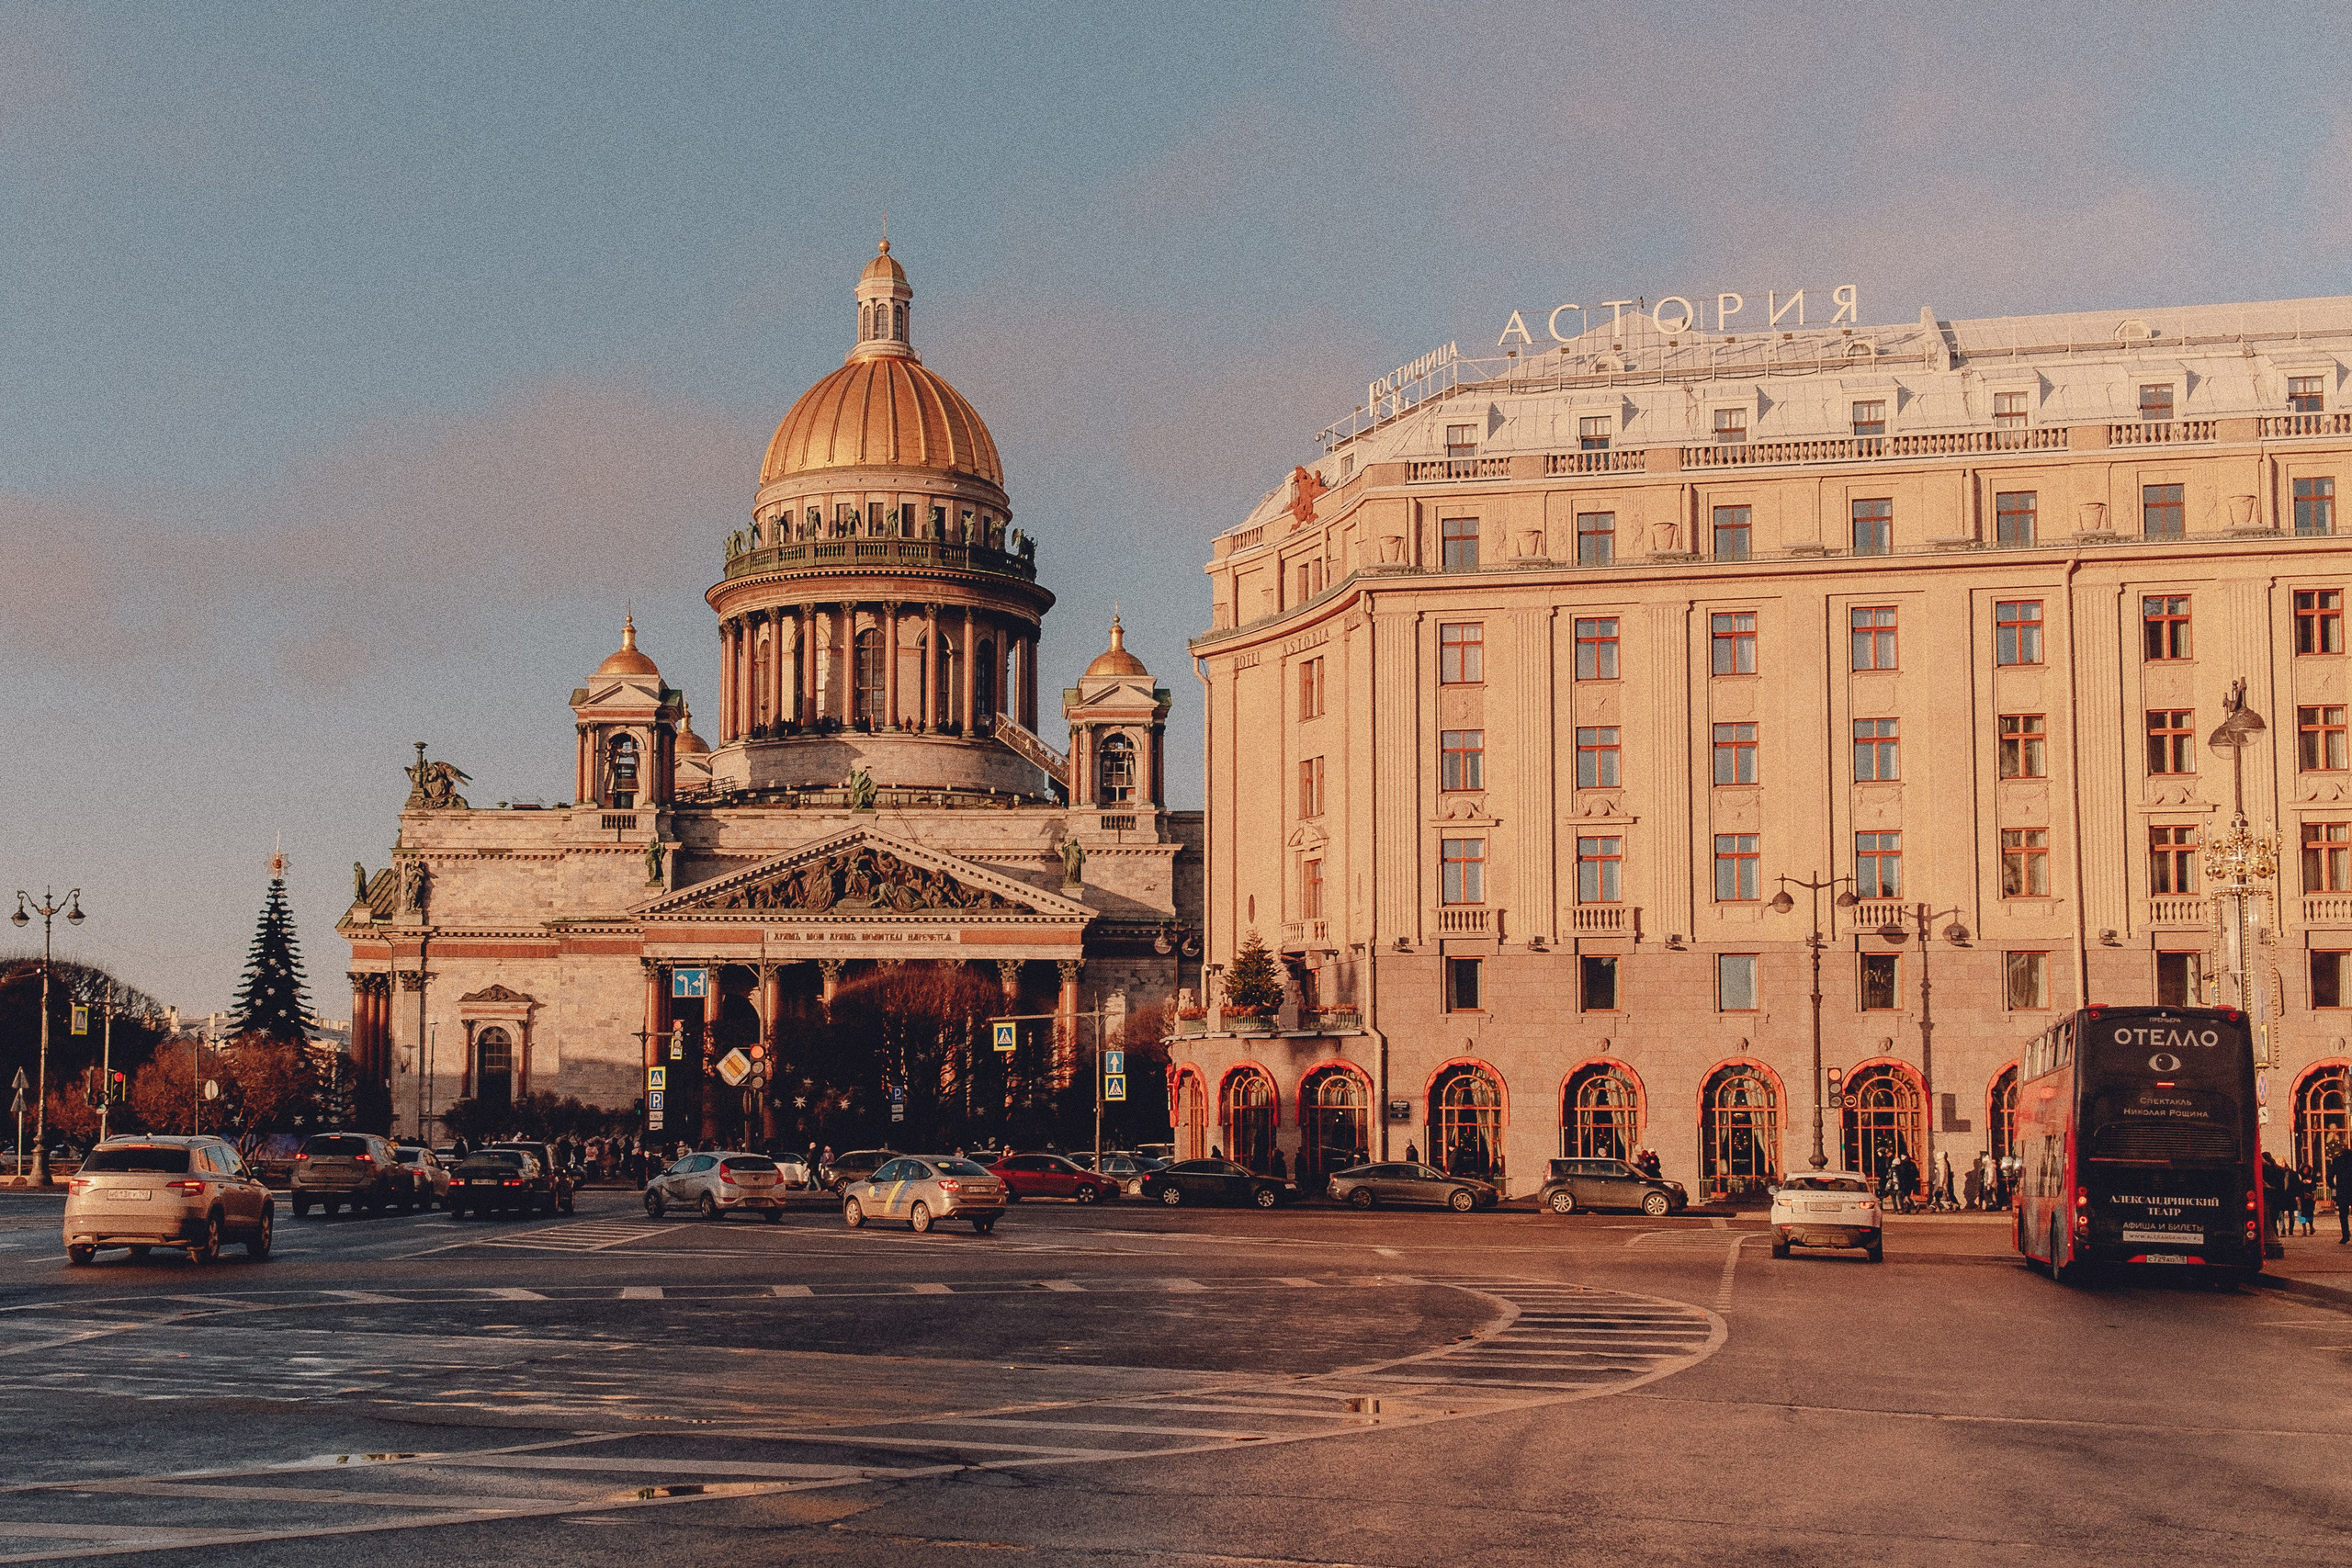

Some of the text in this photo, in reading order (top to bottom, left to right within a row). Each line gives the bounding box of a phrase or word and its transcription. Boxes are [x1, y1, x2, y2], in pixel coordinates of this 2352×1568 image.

[1498, 284, 1859, 345] АСТОРИЯ
[1369, 340, 1458, 404] ГОСТИНИЦА
[2114, 1028, 2219, 1047] ОТЕЛЛО
[2109, 1195, 2221, 1207] АЛЕКСАНДРИНСКИЙ
[2146, 1207, 2182, 1217] ТЕАТР
[2122, 1222, 2156, 1230] АФИША
[2168, 1224, 2205, 1232] БИЛЕТЫ
